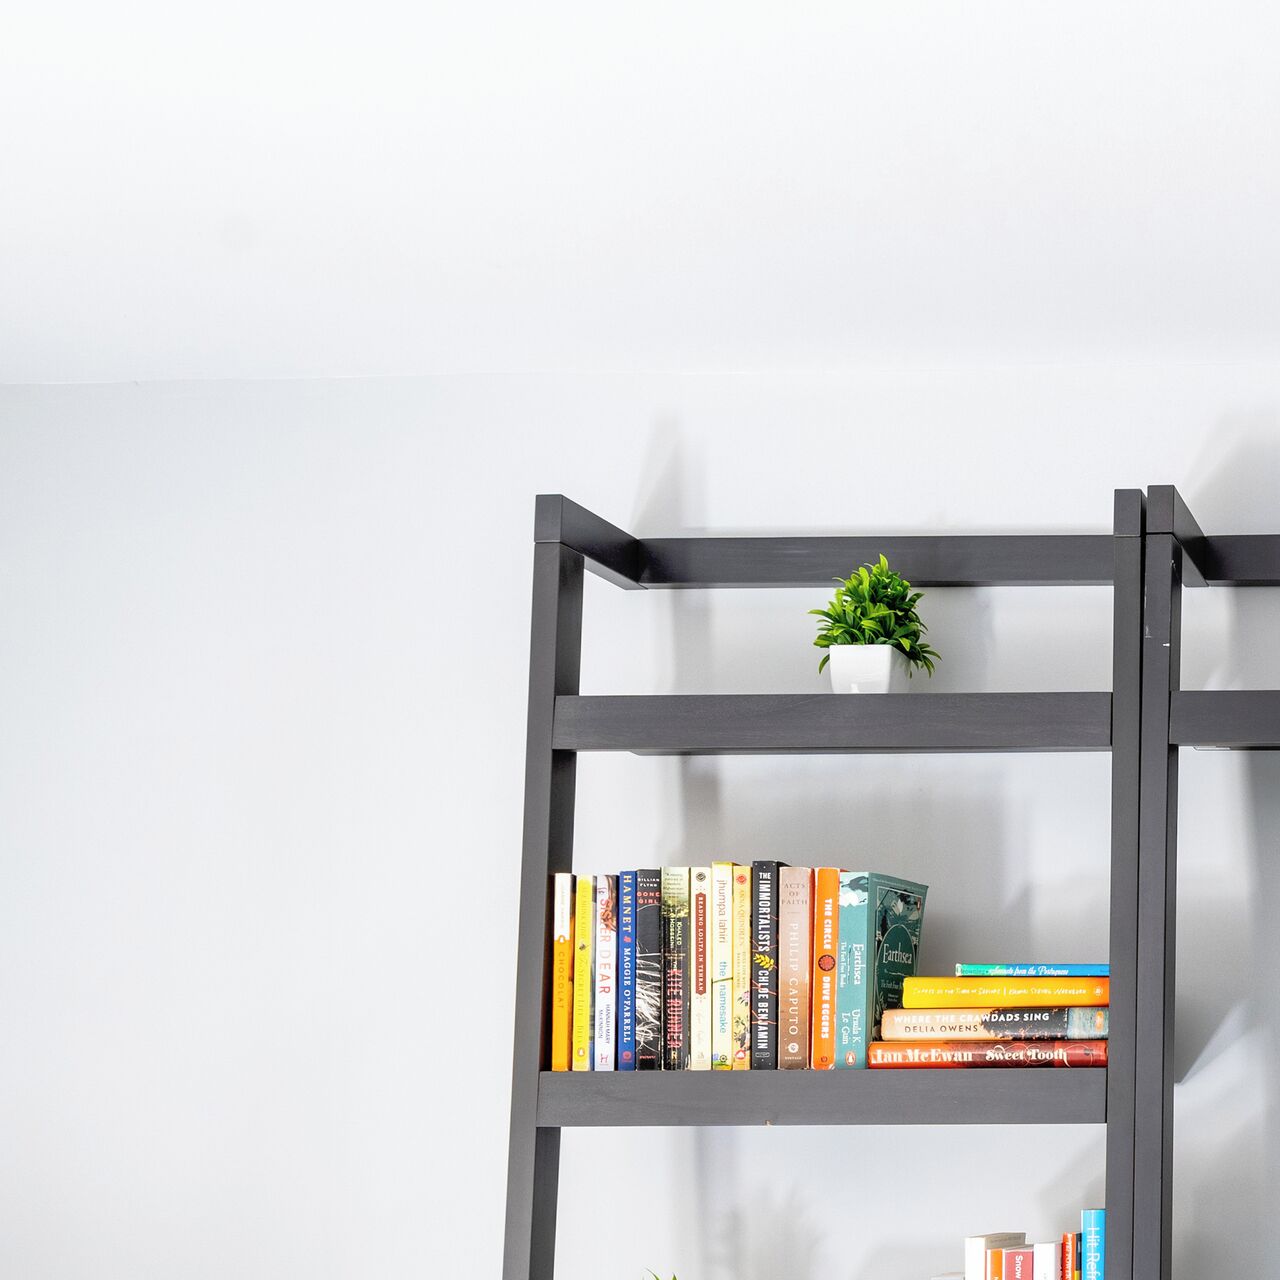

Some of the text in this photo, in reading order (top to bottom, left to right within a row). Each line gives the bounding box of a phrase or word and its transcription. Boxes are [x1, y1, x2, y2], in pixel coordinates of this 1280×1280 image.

[758, 872, 771, 880] THE
[622, 875, 632, 933] HAMNET
[717, 879, 728, 943] jhumpa lahiri
[823, 899, 833, 950] THE CIRCLE
[599, 898, 613, 994] SISTER DEAR
[623, 947, 631, 986] MAGGIE
[698, 955, 704, 963] IN
[757, 881, 771, 1049] IMMORTALISTS CHLOE BENJAMIN
[853, 943, 865, 985] Earthsea
[883, 942, 912, 964] Earthsea
[557, 951, 565, 1008] CHOCOLAT
[667, 969, 683, 996] KITE
[719, 961, 728, 1034] the namesake
[789, 923, 799, 1035] PHILIP CAPUTO
[623, 989, 631, 1043] O'FARRELL
[667, 999, 683, 1048] RUNNER
[821, 976, 831, 1038] DAVE EGGERS
[893, 1013, 1050, 1023] WHERE THE CRAWDADS SING
[871, 1045, 1069, 1065] Ian McEwan Sweet Tooth
[1086, 1227, 1100, 1249] Hit
[1015, 1255, 1024, 1278] Snow
